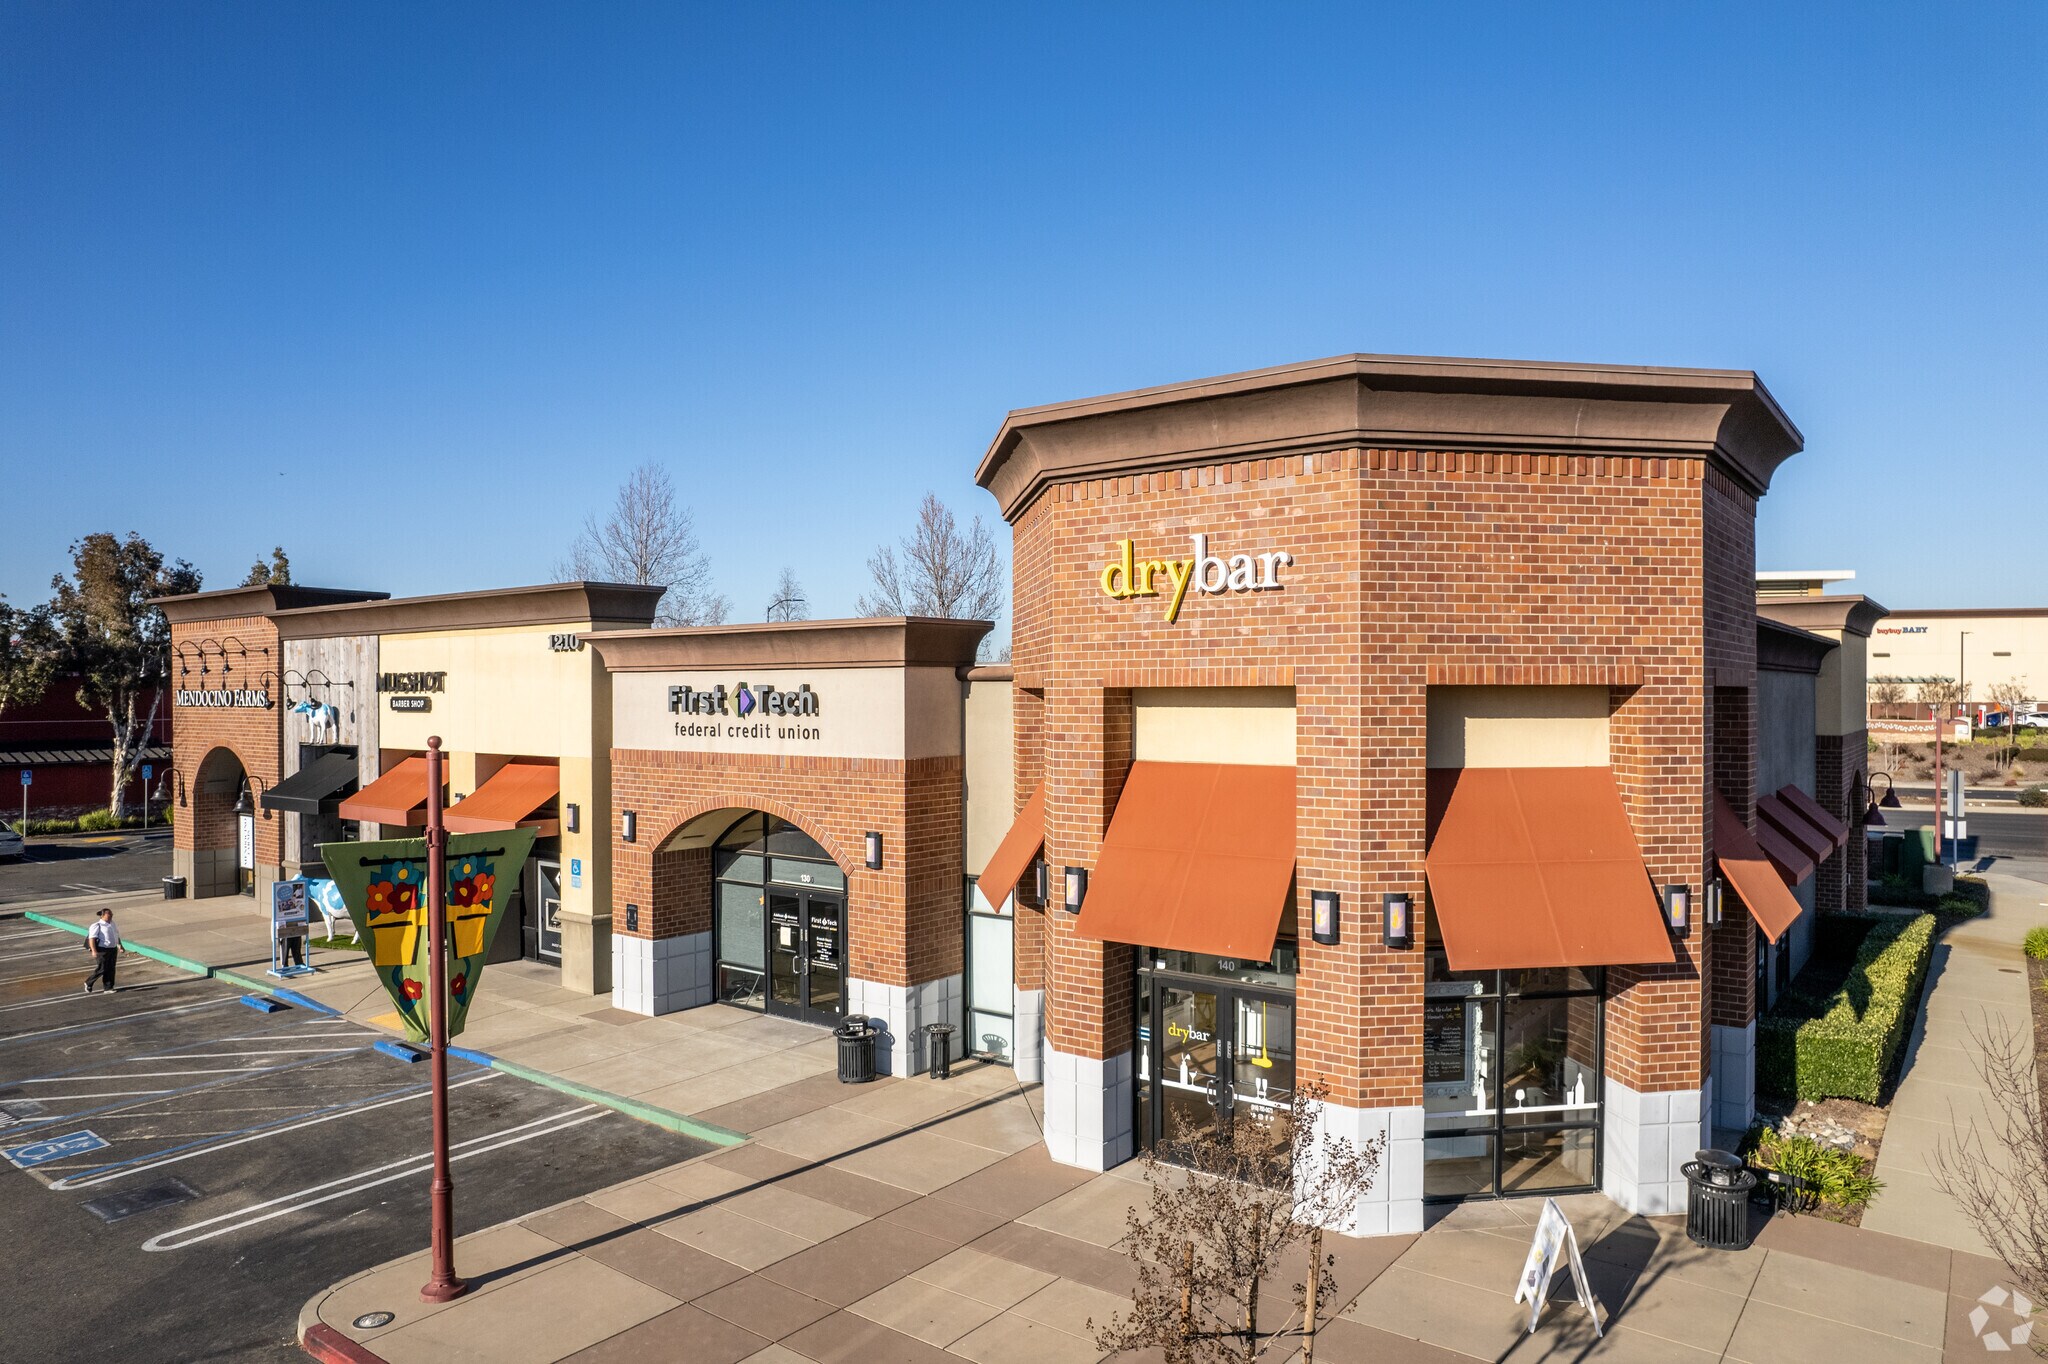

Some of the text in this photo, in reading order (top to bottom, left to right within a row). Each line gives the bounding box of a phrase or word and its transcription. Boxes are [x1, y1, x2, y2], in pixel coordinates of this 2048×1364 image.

[1100, 533, 1292, 622] drybar
[548, 633, 580, 650] 1210
[375, 671, 447, 692] MUGSHOT
[176, 688, 266, 707] MENDOCINO FARMS
[392, 700, 425, 708] BARBER SHOP
[668, 683, 818, 716] First Tech
[674, 722, 820, 740] federal credit union
[800, 874, 811, 883] 130
[1218, 959, 1235, 972] 140
[1168, 1022, 1211, 1043] drybar
